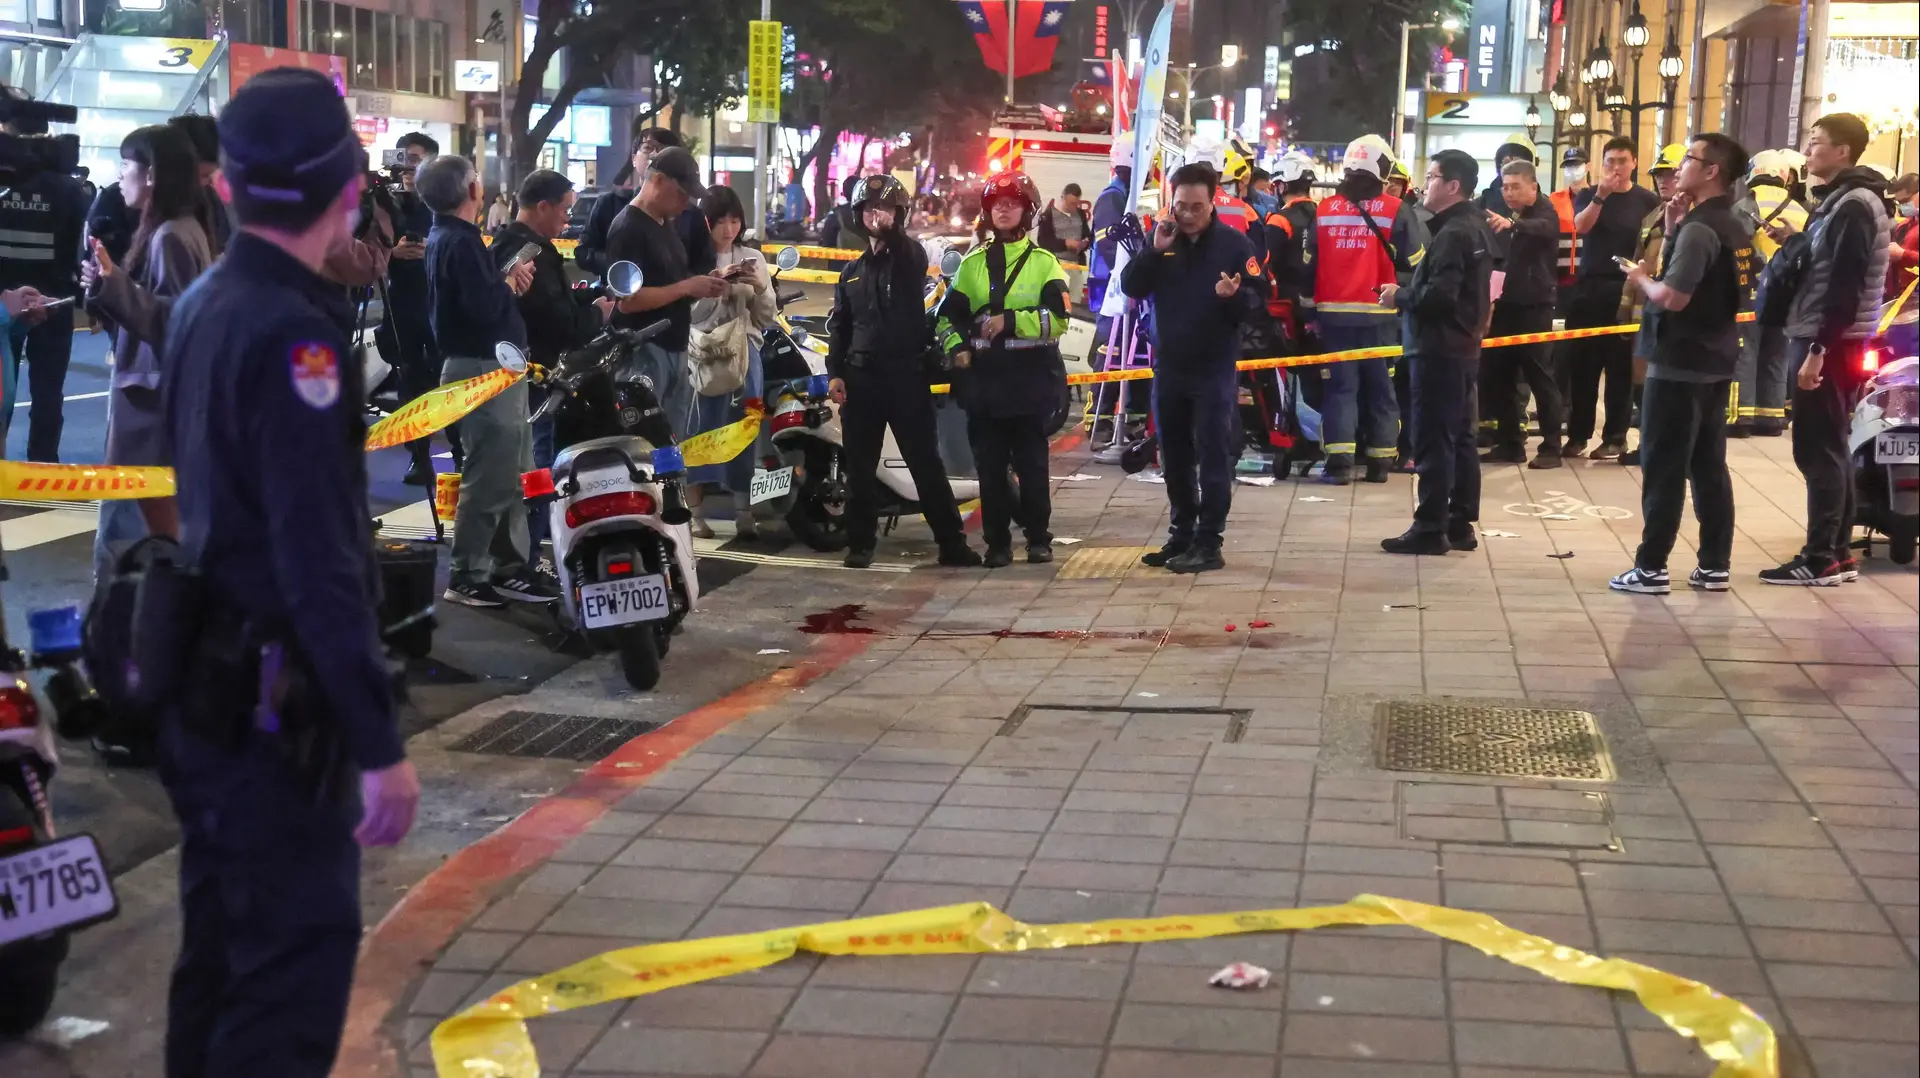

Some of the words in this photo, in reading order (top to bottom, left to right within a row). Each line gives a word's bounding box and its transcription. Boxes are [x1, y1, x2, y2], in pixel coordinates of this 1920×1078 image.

[158, 47, 193, 67] 3
[1478, 25, 1496, 87] NET
[1441, 99, 1470, 118] 2
[3, 200, 50, 211] POLICE
[1336, 239, 1367, 249] 消防局
